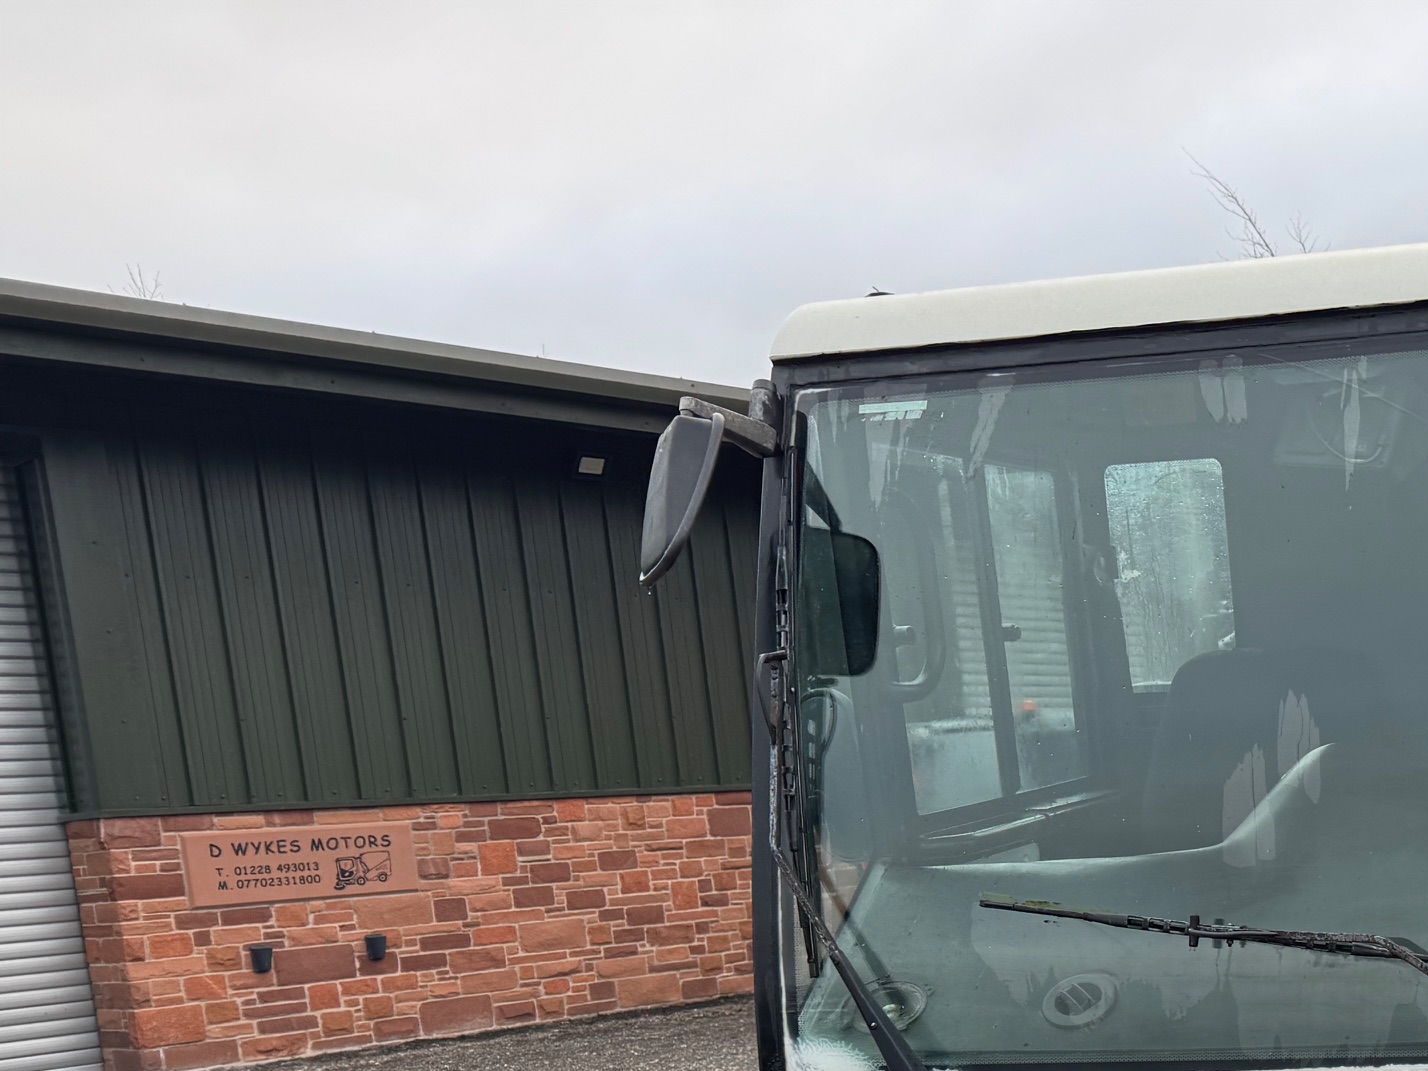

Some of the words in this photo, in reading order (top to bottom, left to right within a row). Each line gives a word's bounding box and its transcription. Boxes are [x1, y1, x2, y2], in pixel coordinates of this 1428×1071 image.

[209, 843, 222, 858] D
[230, 839, 301, 857] WYKES
[310, 834, 391, 852] MOTORS
[215, 867, 229, 878] T.
[234, 865, 272, 876] 01228
[276, 861, 320, 874] 493013
[217, 880, 234, 891] M.
[236, 874, 322, 889] 07702331800
